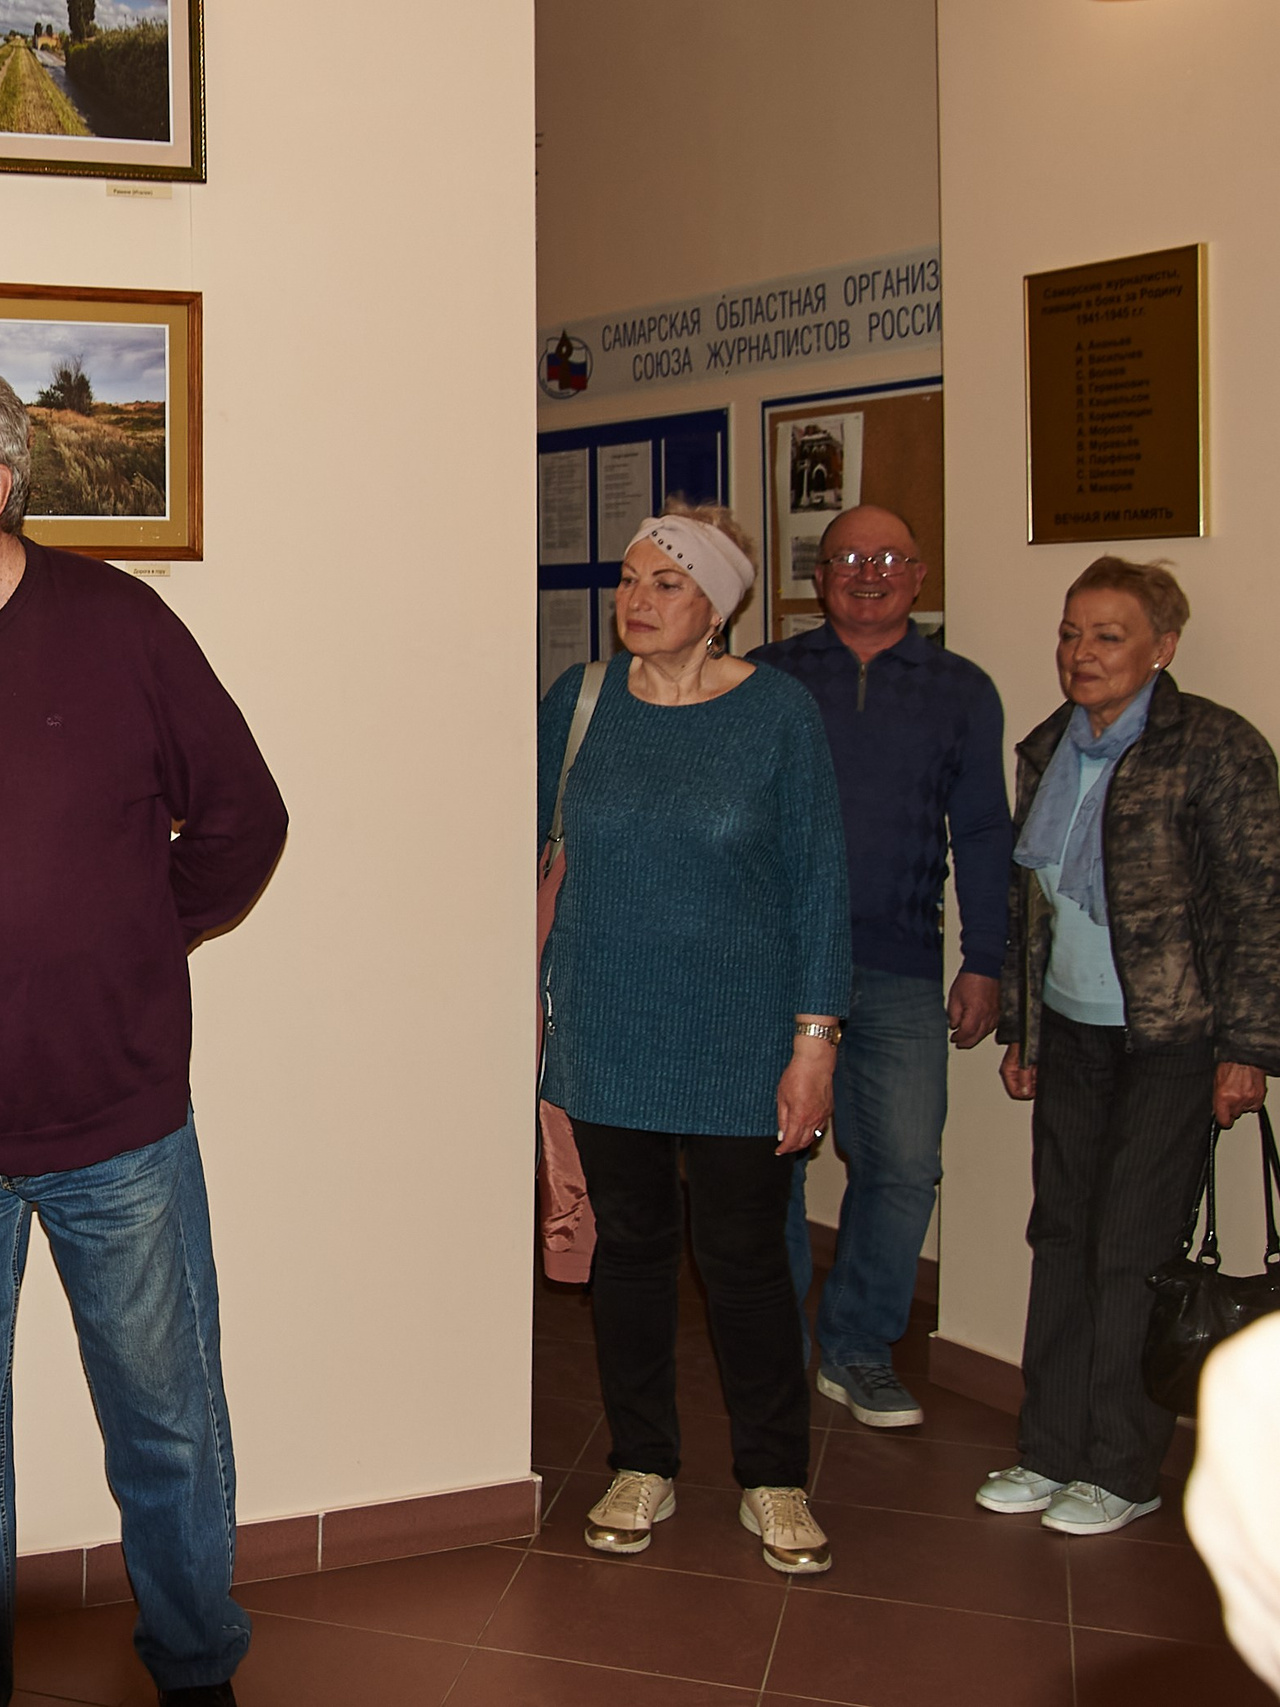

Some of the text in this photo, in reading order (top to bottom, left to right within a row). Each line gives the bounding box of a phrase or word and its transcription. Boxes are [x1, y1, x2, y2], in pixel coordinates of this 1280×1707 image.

[1043, 269, 1180, 300] Самарские журналисты,
[1085, 299, 1093, 308] в
[1094, 294, 1121, 306] боях
[1124, 292, 1137, 303] за
[1140, 285, 1183, 299] Родину
[602, 258, 940, 352] САМАРСКАЯ ОБЛАСТНАЯ ОРГАНИЗ
[1076, 306, 1130, 326] 1941-1945
[633, 300, 941, 382] СОЮЗА ЖУРНАЛИСТОВ РОССИ
[1054, 507, 1174, 525] ВЕЧНАЯ ИМ ПАМЯТЬ
